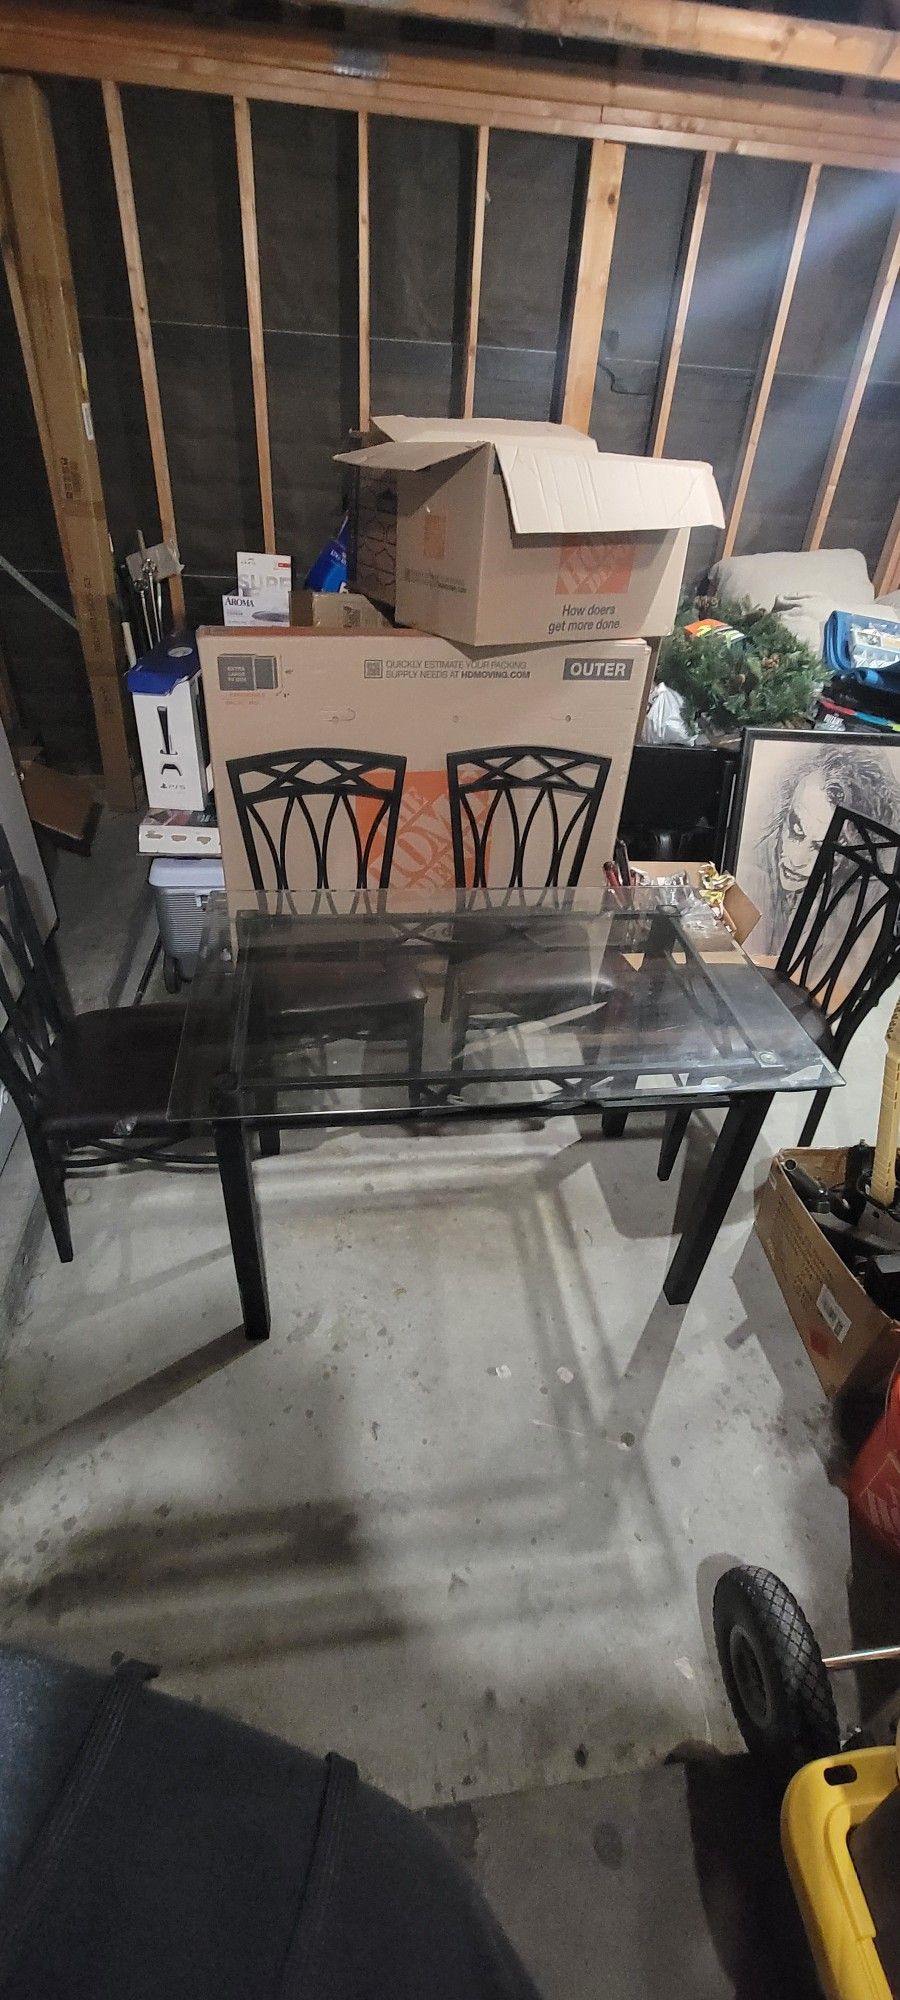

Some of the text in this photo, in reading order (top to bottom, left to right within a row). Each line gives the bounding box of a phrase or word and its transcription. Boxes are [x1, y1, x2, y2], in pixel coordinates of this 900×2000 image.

[225, 597, 255, 607] AROMA
[562, 603, 616, 616] How doers
[548, 620, 566, 635] get
[567, 621, 594, 632] more
[385, 659, 527, 670] QUICKLY ESTIMATE YOUR PACKING
[570, 662, 626, 677] OUTER
[385, 669, 530, 680] SUPPLY NEEDS AT HDMOVING.COM
